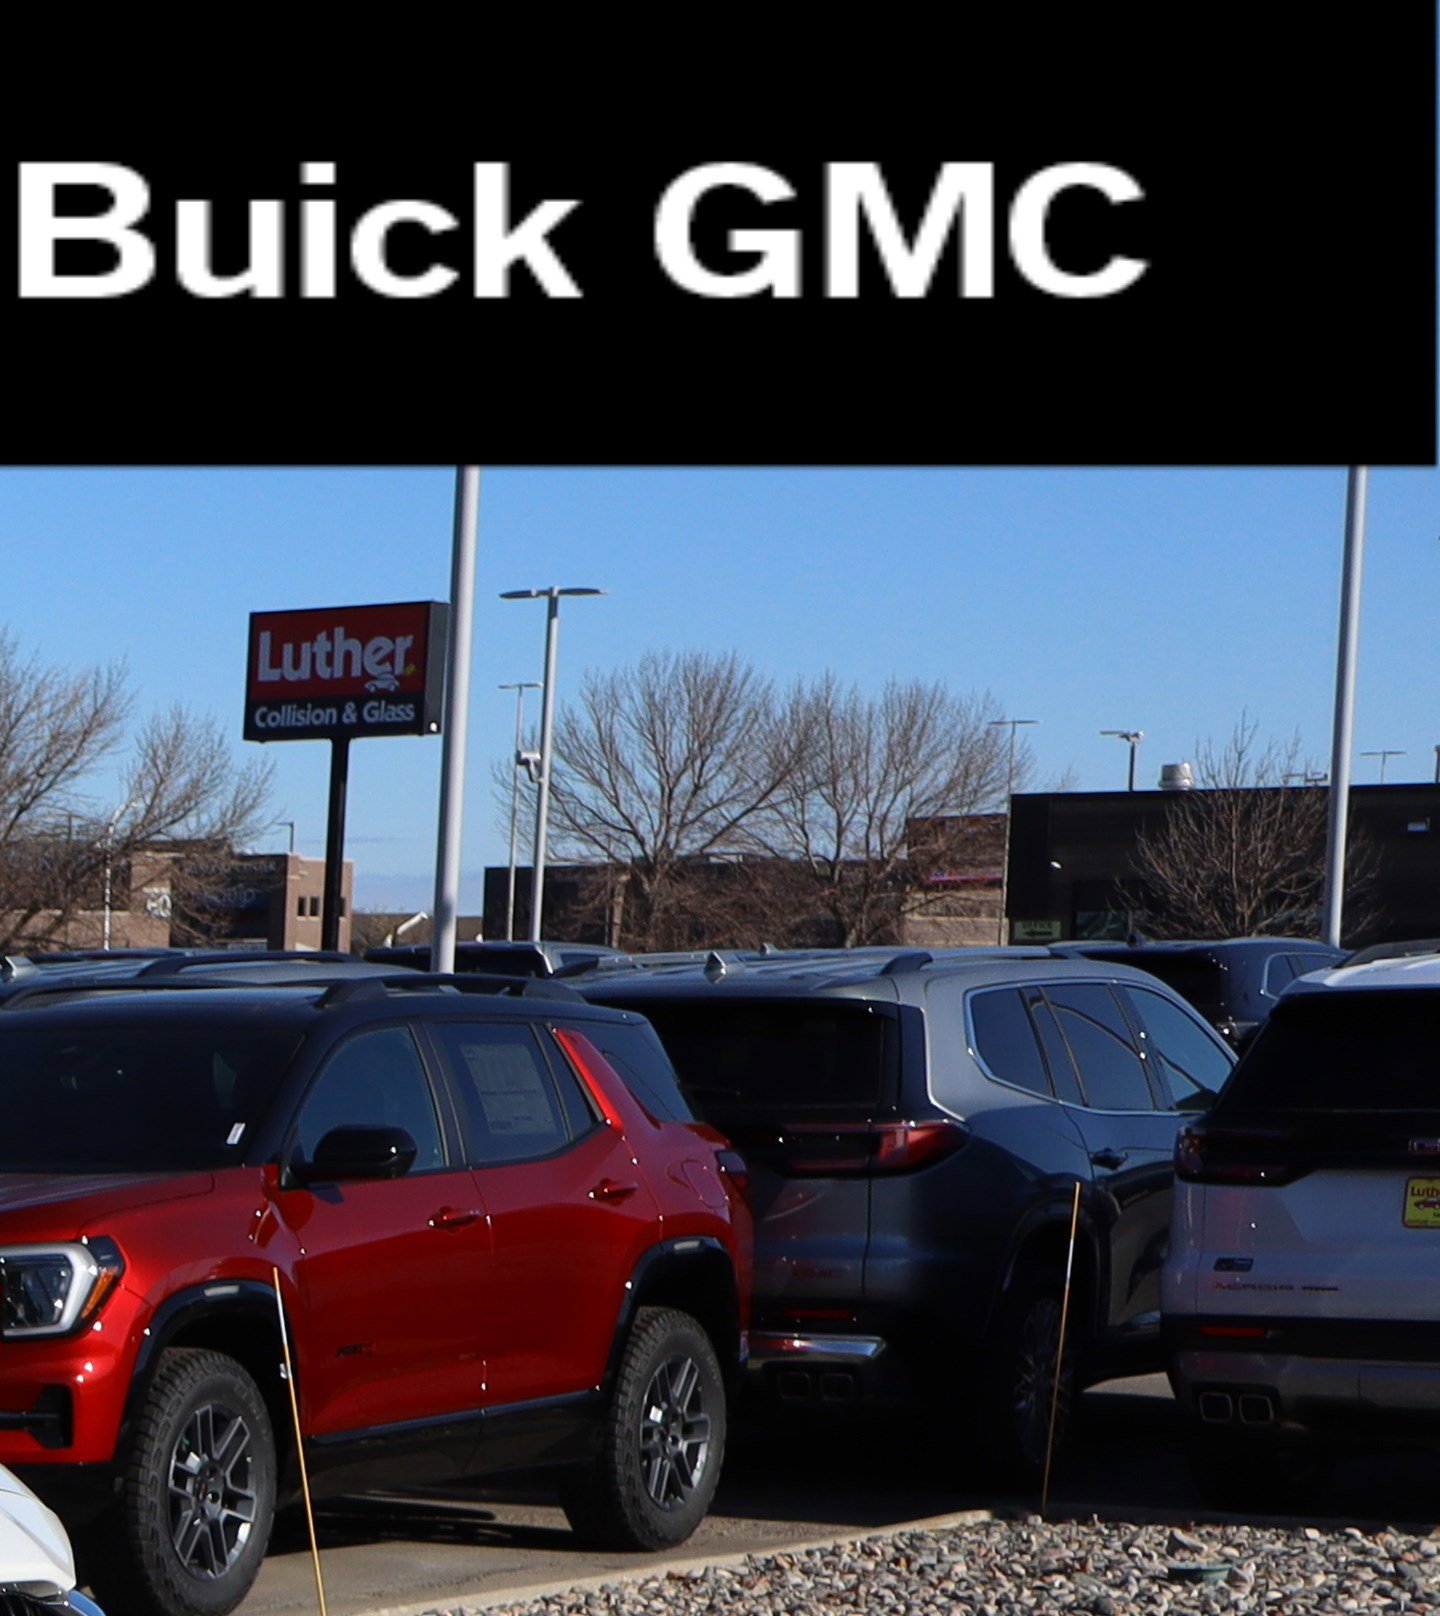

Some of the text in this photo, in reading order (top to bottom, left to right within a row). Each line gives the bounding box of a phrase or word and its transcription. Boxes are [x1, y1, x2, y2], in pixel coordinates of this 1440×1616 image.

[257, 626, 414, 682] Luther
[254, 700, 415, 728] Collision & Glass
[1410, 1186, 1440, 1197] Luth
